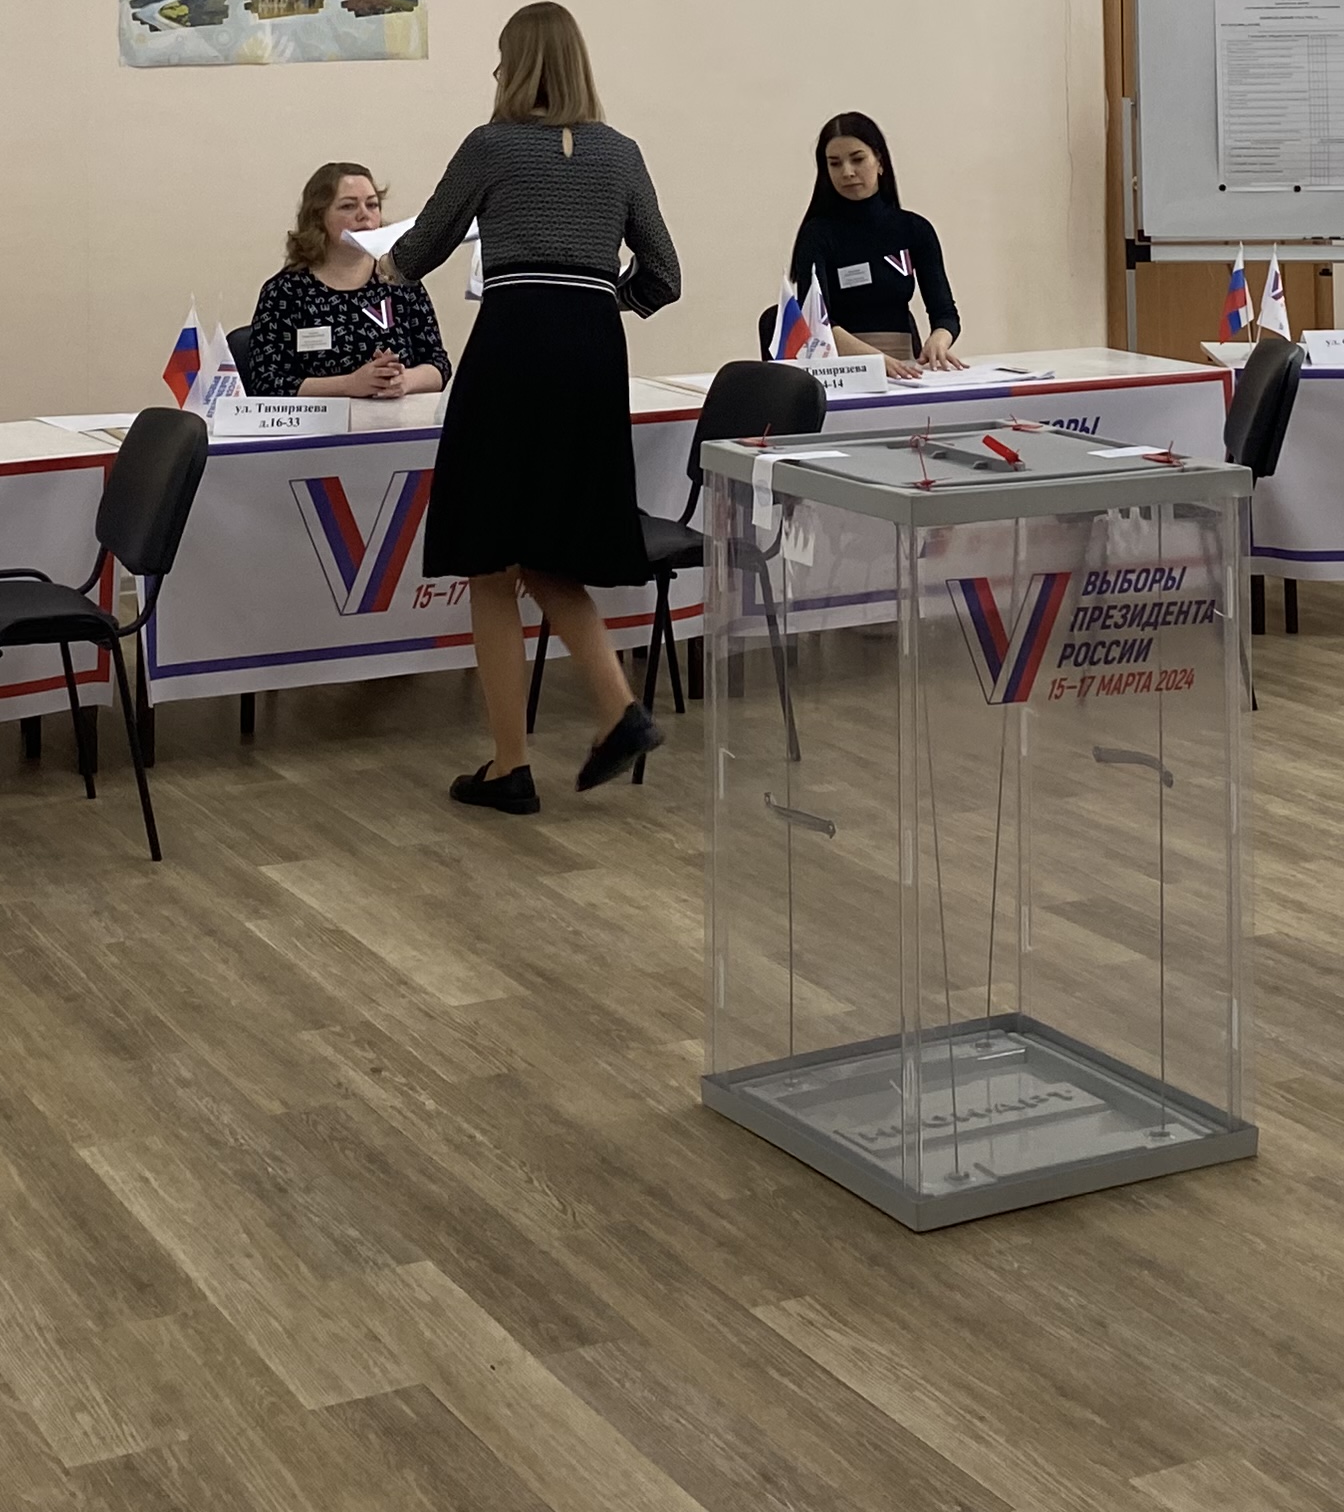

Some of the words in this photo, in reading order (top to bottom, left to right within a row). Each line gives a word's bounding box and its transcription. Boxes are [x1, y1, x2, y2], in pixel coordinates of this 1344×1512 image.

[235, 405, 252, 415] ул.
[256, 403, 327, 416] Тимирязева
[259, 417, 300, 429] д.16-33
[1081, 566, 1187, 597] ВЫБОРЫ
[1070, 598, 1215, 634] ПРЕЗИДЕНТА
[1057, 636, 1154, 669] РОССИИ
[1096, 671, 1154, 699] МАРТА
[1156, 668, 1195, 695] 2024
